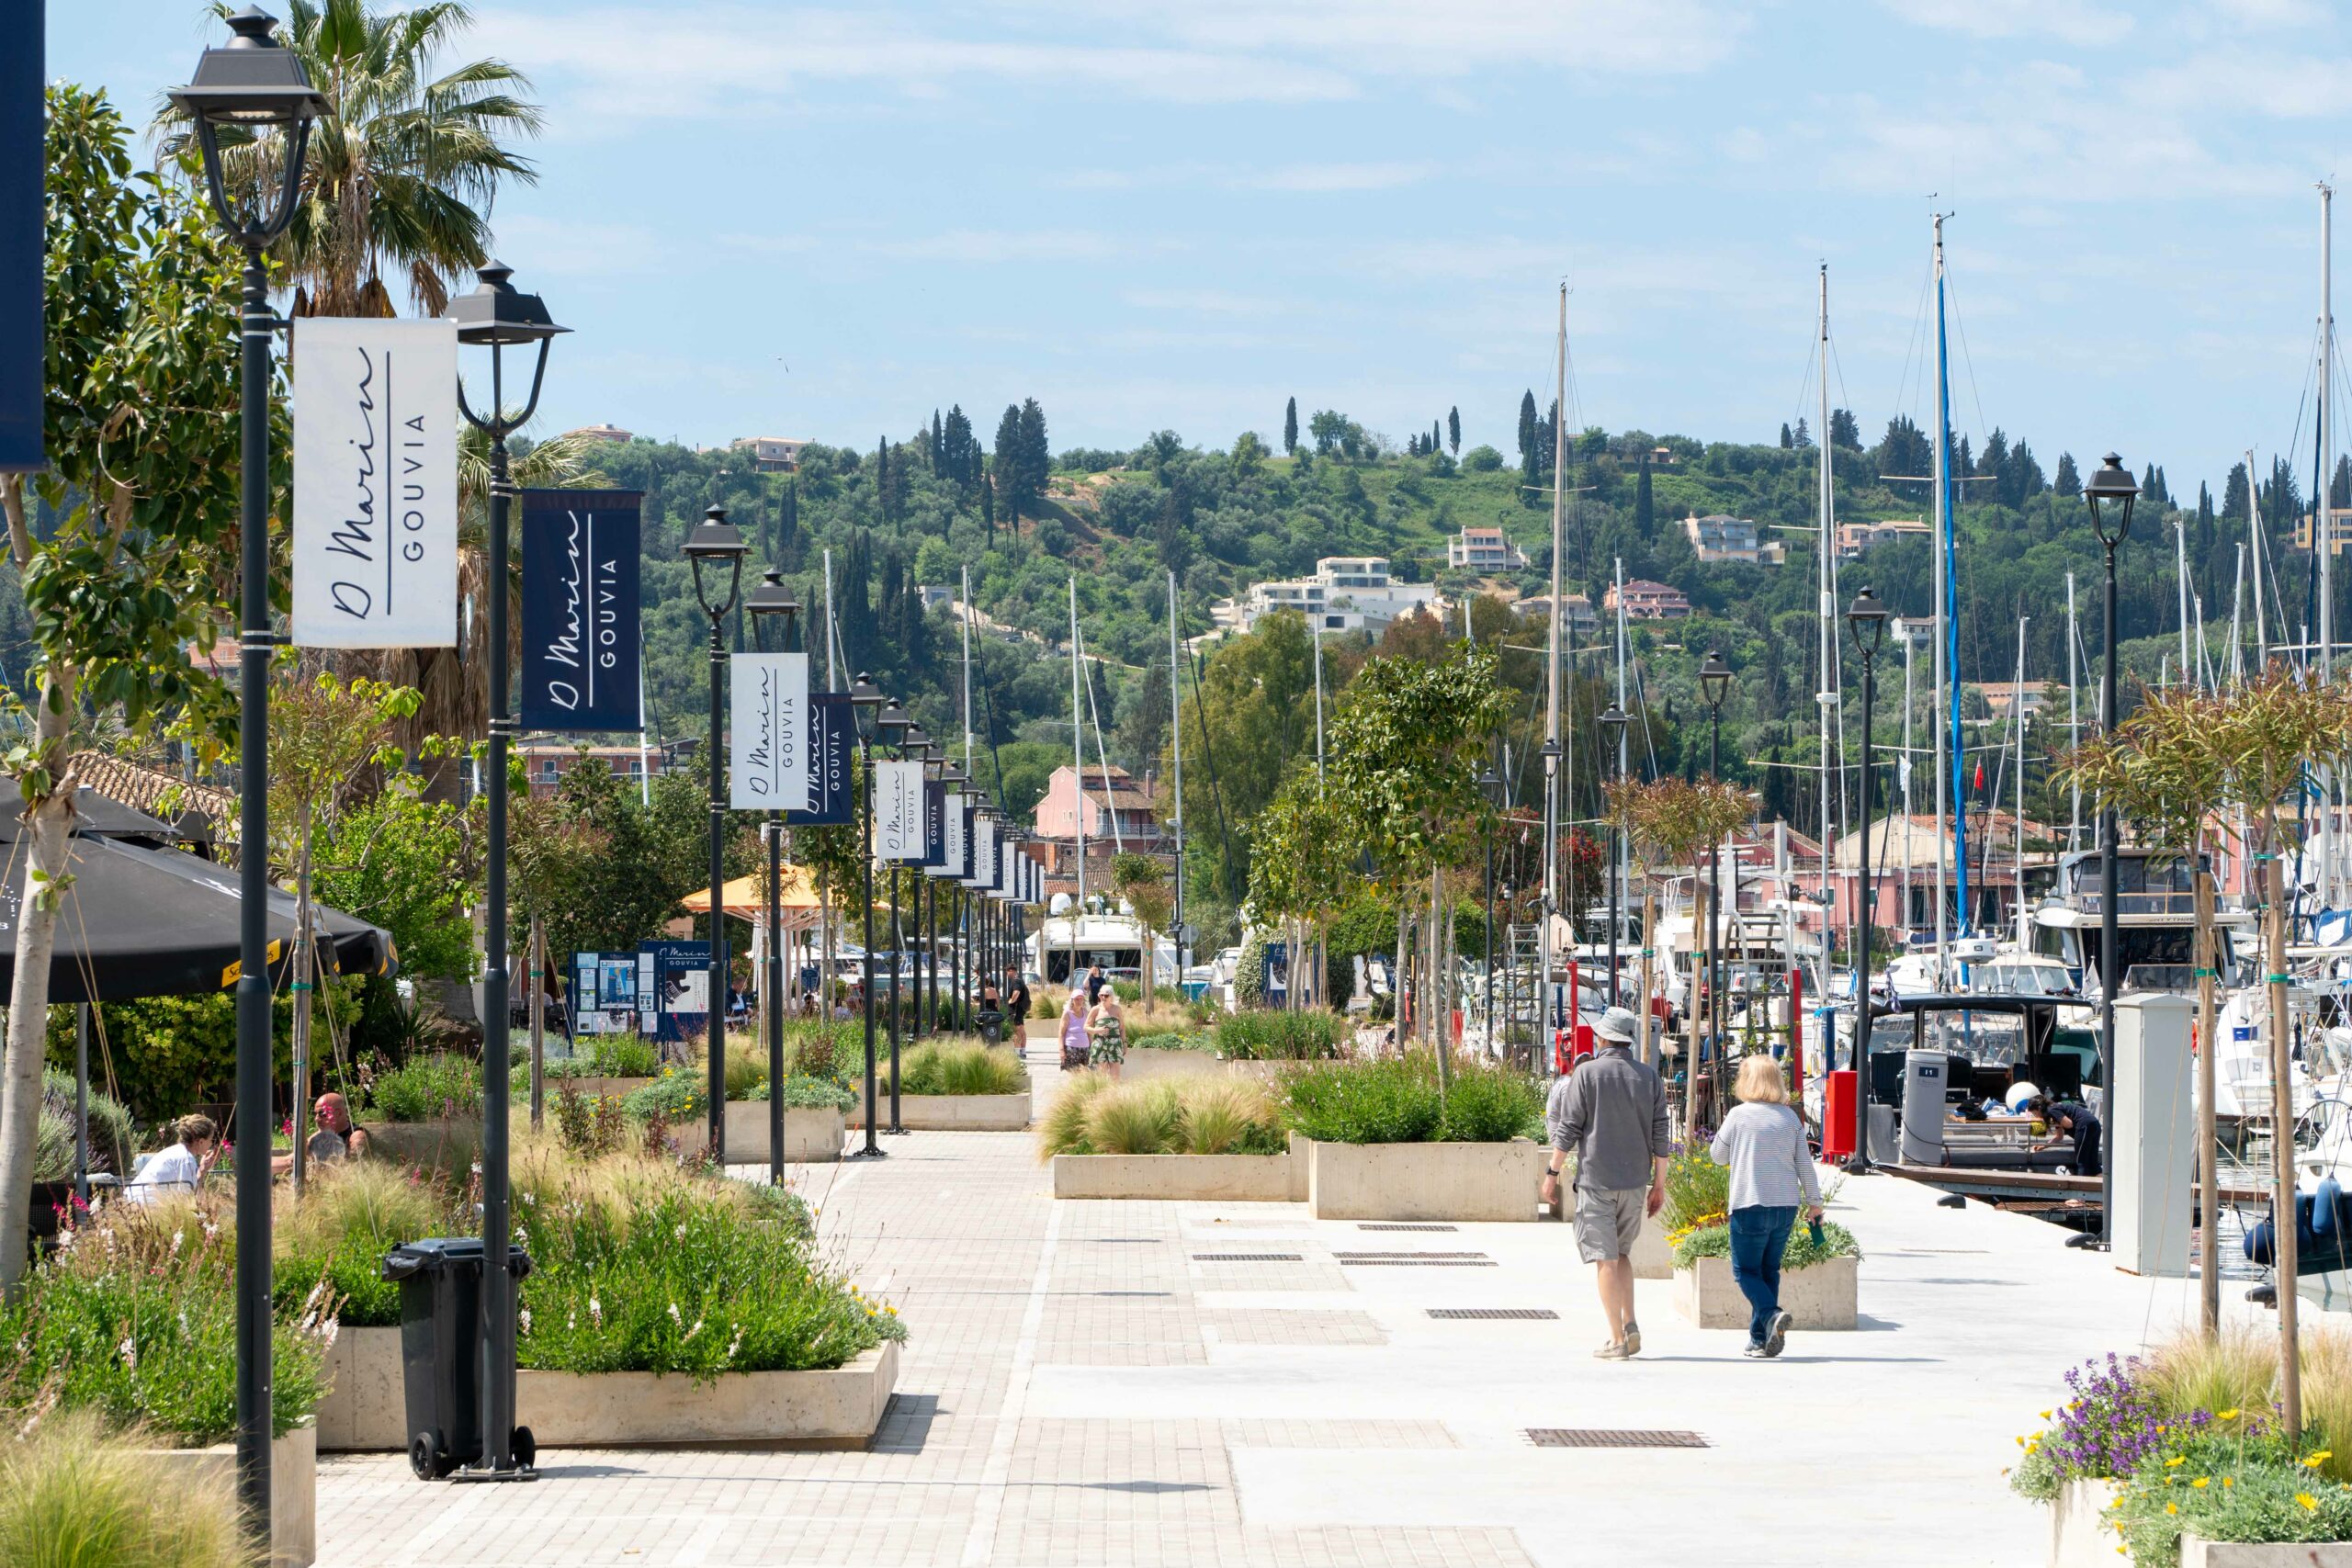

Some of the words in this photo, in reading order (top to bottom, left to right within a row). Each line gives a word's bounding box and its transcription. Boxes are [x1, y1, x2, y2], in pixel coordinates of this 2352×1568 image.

[325, 345, 375, 562] Marin
[402, 414, 424, 562] GOUVIA
[331, 581, 371, 620] D
[544, 510, 580, 668] Marin
[599, 559, 616, 669] GOUVIA
[548, 681, 579, 711] D
[746, 666, 770, 768] Marin
[782, 698, 793, 768] GOUVIA
[808, 705, 820, 791] Marin
[830, 731, 840, 792] GOUVIA
[749, 776, 769, 795] D
[886, 771, 900, 834] Marin
[887, 839, 900, 852] D
[670, 946, 711, 956] Marin
